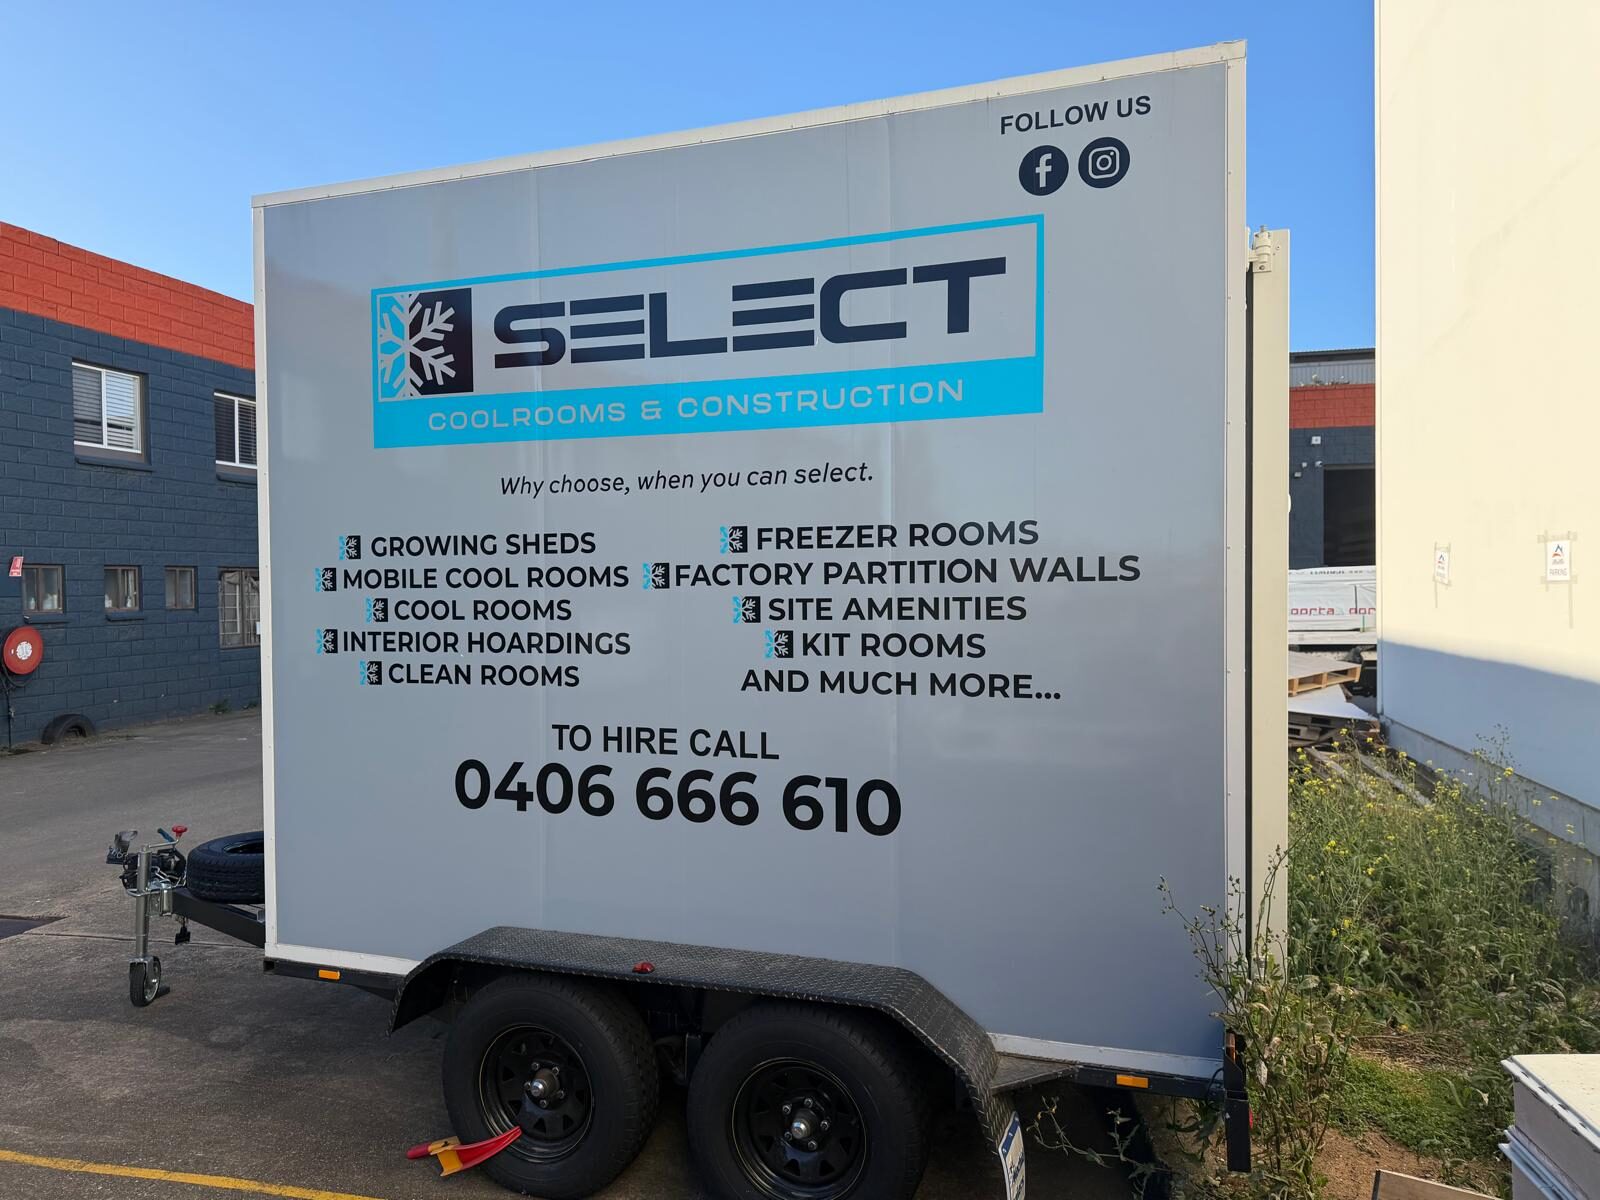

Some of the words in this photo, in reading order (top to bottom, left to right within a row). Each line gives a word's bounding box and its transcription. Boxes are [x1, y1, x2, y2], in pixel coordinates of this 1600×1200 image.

[1001, 101, 1108, 134] FOLLOW
[1117, 96, 1150, 117] US
[494, 257, 1006, 368] SELECT
[429, 403, 625, 430] COOLROOMS
[641, 401, 661, 420] &
[677, 379, 964, 419] CONSTRUCTION
[501, 476, 544, 499] Why
[550, 475, 629, 495] choose,
[638, 471, 693, 489] when
[701, 472, 740, 493] you
[747, 470, 786, 485] can
[794, 463, 872, 483] select.
[371, 535, 496, 557] GROWING
[506, 532, 595, 555] SHEDS
[758, 525, 897, 550] FREEZER
[910, 520, 1038, 546] ROOMS
[344, 568, 437, 589] MOBILE
[446, 568, 518, 588] COOL
[528, 566, 628, 587] ROOMS
[676, 563, 813, 586] FACTORY
[824, 559, 996, 584] PARTITION
[1010, 555, 1140, 582] WALLS
[395, 600, 465, 620] COOL
[474, 600, 571, 620] ROOMS
[769, 598, 832, 620] SITE
[842, 596, 1026, 620] AMENITIES
[344, 632, 458, 652] INTERIOR
[468, 632, 630, 654] HOARDINGS
[803, 633, 850, 656] KIT
[862, 633, 985, 658] ROOMS
[389, 664, 470, 684] CLEAN
[481, 665, 579, 687] ROOMS
[741, 670, 809, 692] AND
[821, 671, 916, 695] MUCH
[930, 673, 1060, 699] MORE...
[552, 725, 591, 751] TO
[604, 726, 677, 755] HIRE
[690, 729, 779, 759] CALL
[455, 759, 614, 816] 0406
[636, 768, 759, 826] 666
[783, 775, 901, 836] 610
